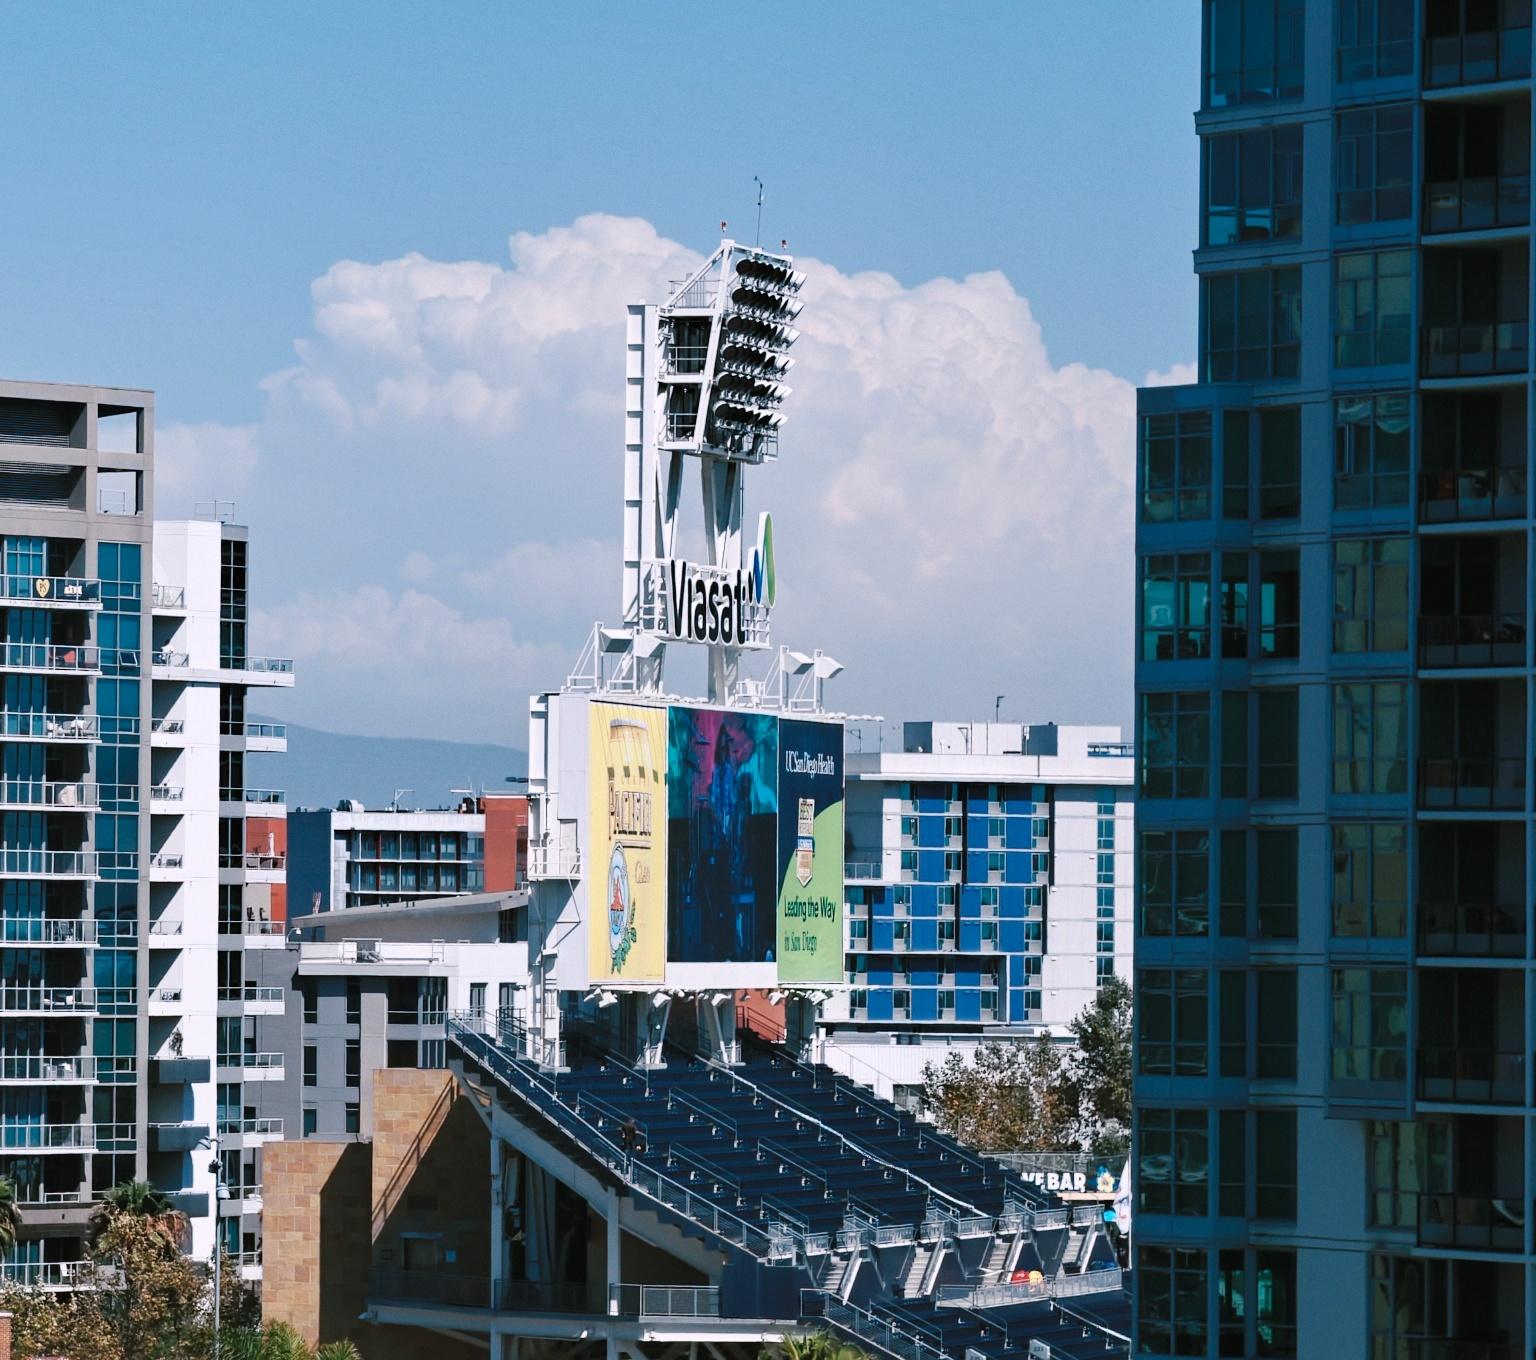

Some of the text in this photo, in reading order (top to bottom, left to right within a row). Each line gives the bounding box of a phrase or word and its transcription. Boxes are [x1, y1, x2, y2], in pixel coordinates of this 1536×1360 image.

[670, 559, 746, 646] Viasat
[818, 753, 835, 776] Health
[784, 895, 837, 923] Leading the Way
[1047, 1172, 1086, 1192] BAR
